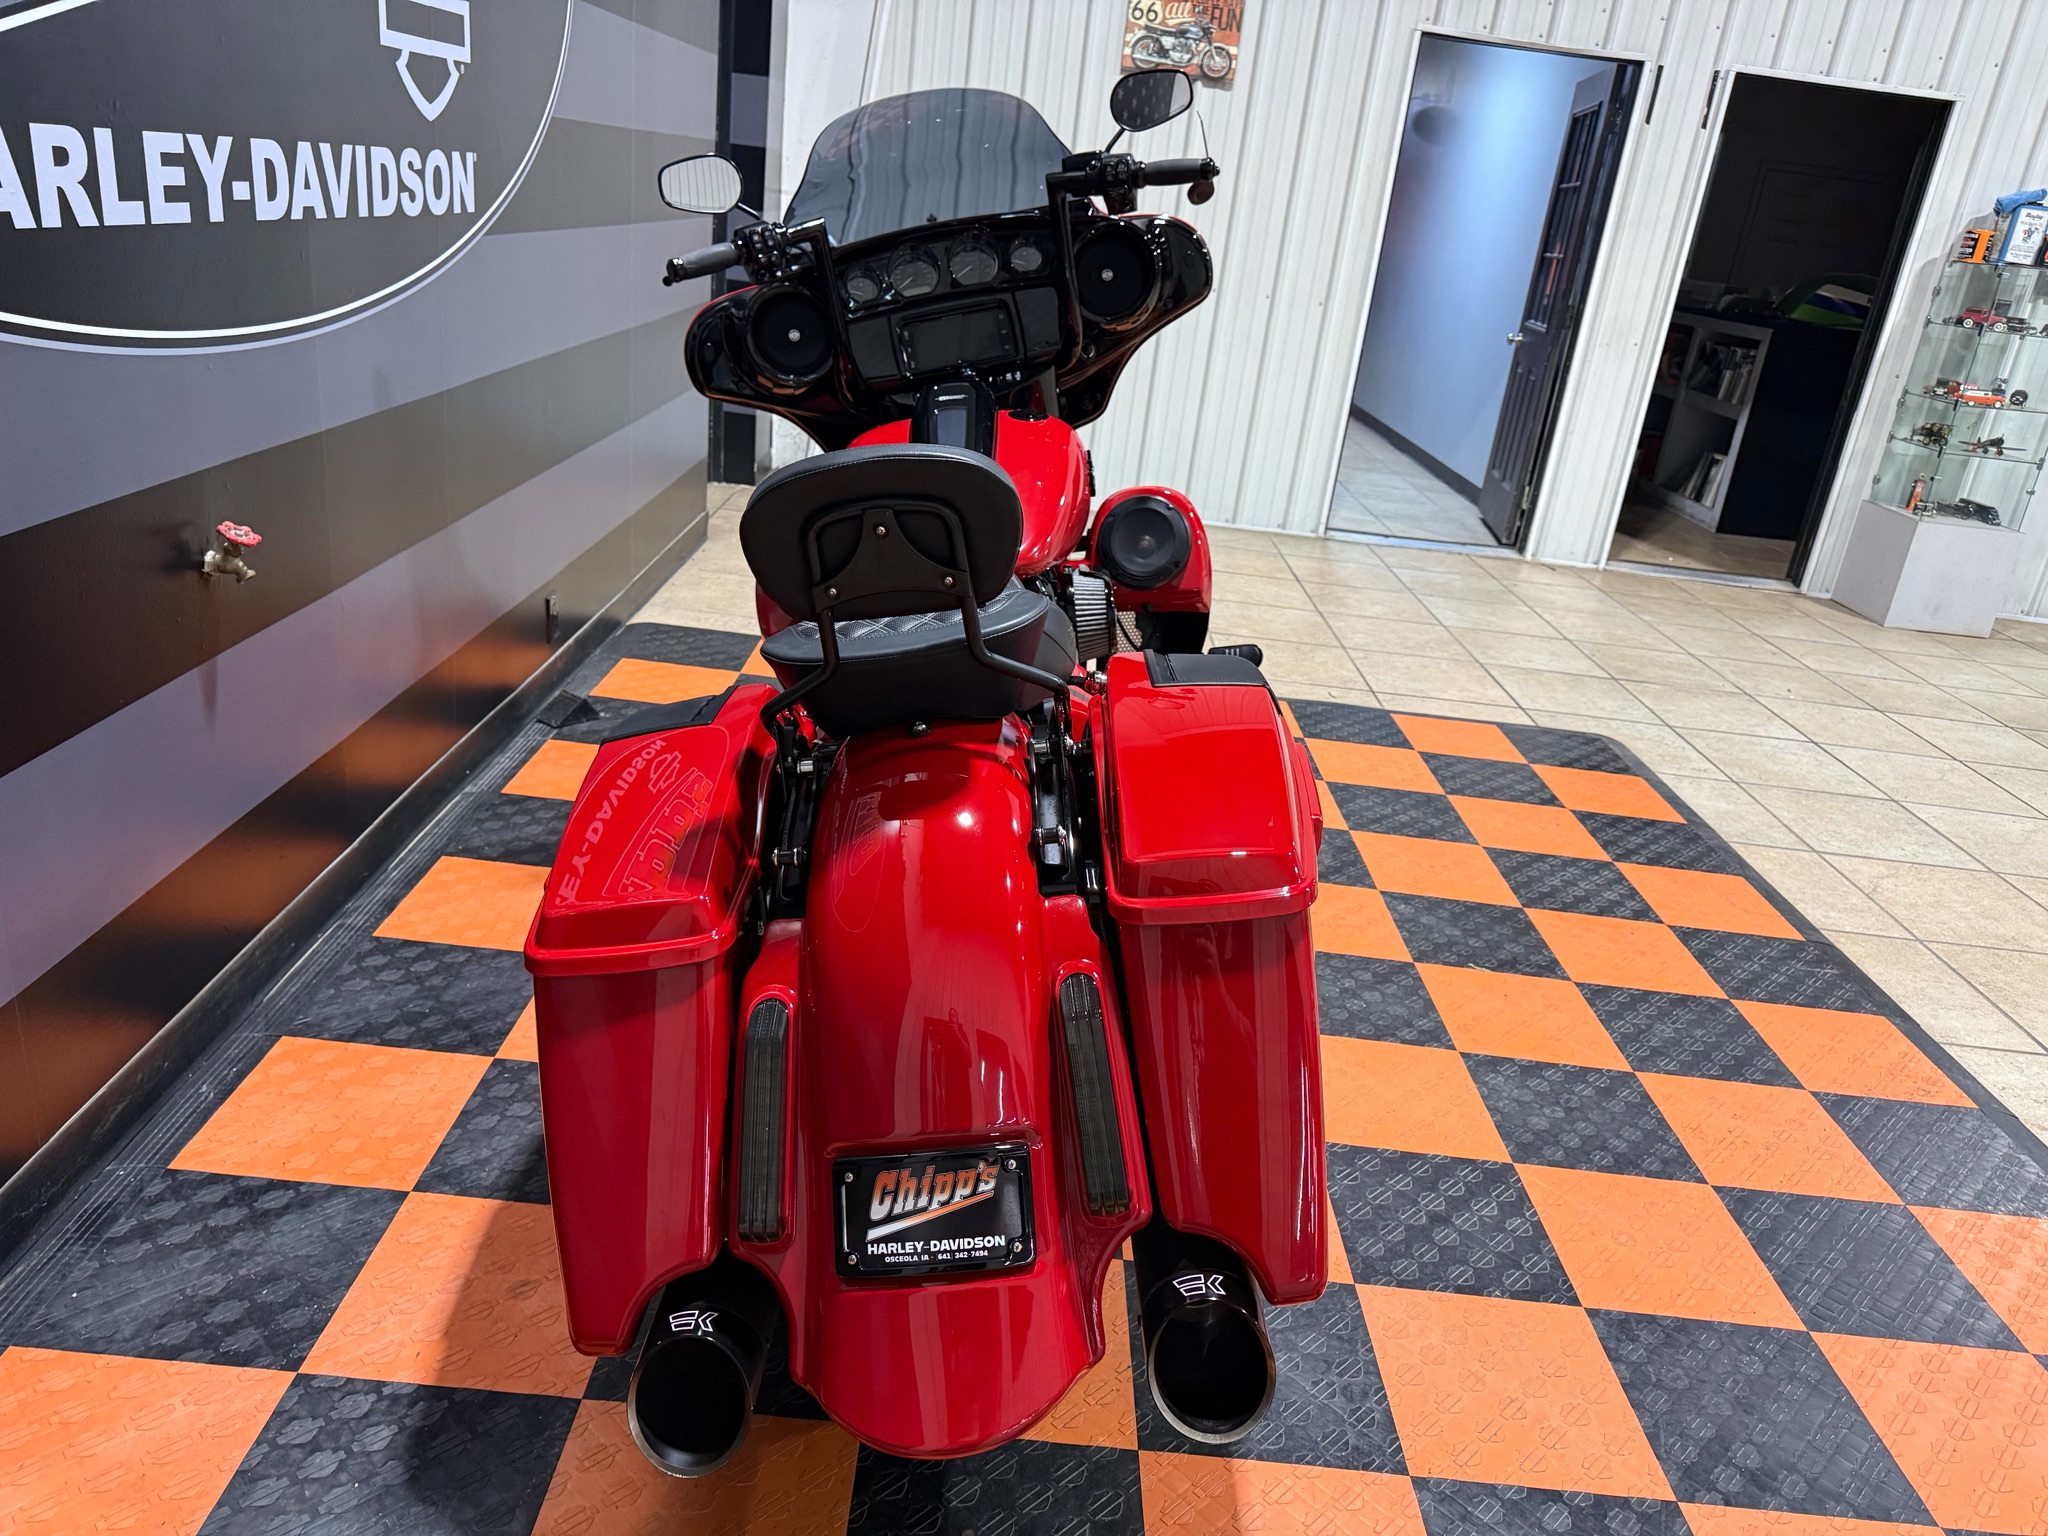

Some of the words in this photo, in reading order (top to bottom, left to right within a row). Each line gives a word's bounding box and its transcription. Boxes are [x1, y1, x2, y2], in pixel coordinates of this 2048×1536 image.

[1131, 0, 1159, 22] 66
[1165, 1, 1193, 19] all
[1210, 6, 1244, 32] FUN
[869, 1160, 1000, 1222] Chipp's
[867, 1235, 1006, 1255] HARLEY-DAVIDSON
[884, 1255, 919, 1263] OSCEOLA
[955, 1250, 988, 1259] 342-7494
